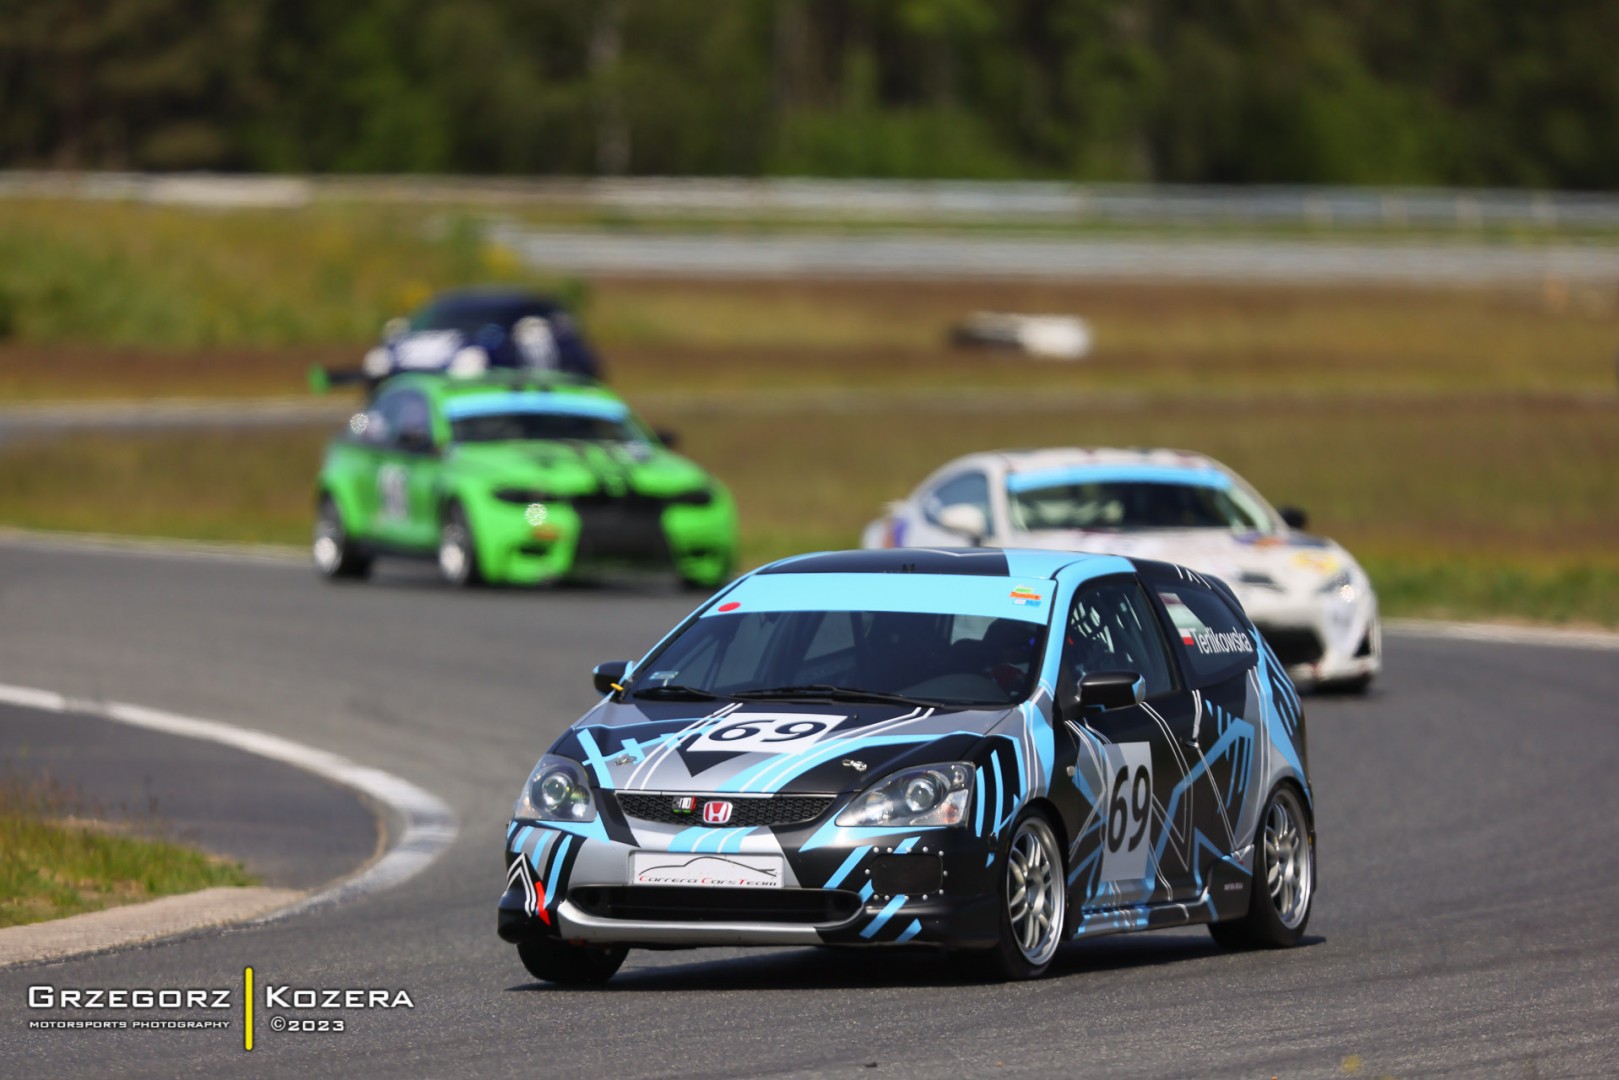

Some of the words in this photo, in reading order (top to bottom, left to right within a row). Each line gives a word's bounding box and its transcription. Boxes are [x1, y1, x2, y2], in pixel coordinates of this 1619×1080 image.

[1189, 626, 1253, 654] Terlikowska
[708, 719, 827, 743] 69
[1107, 764, 1152, 853] 69
[639, 875, 697, 884] Carrera
